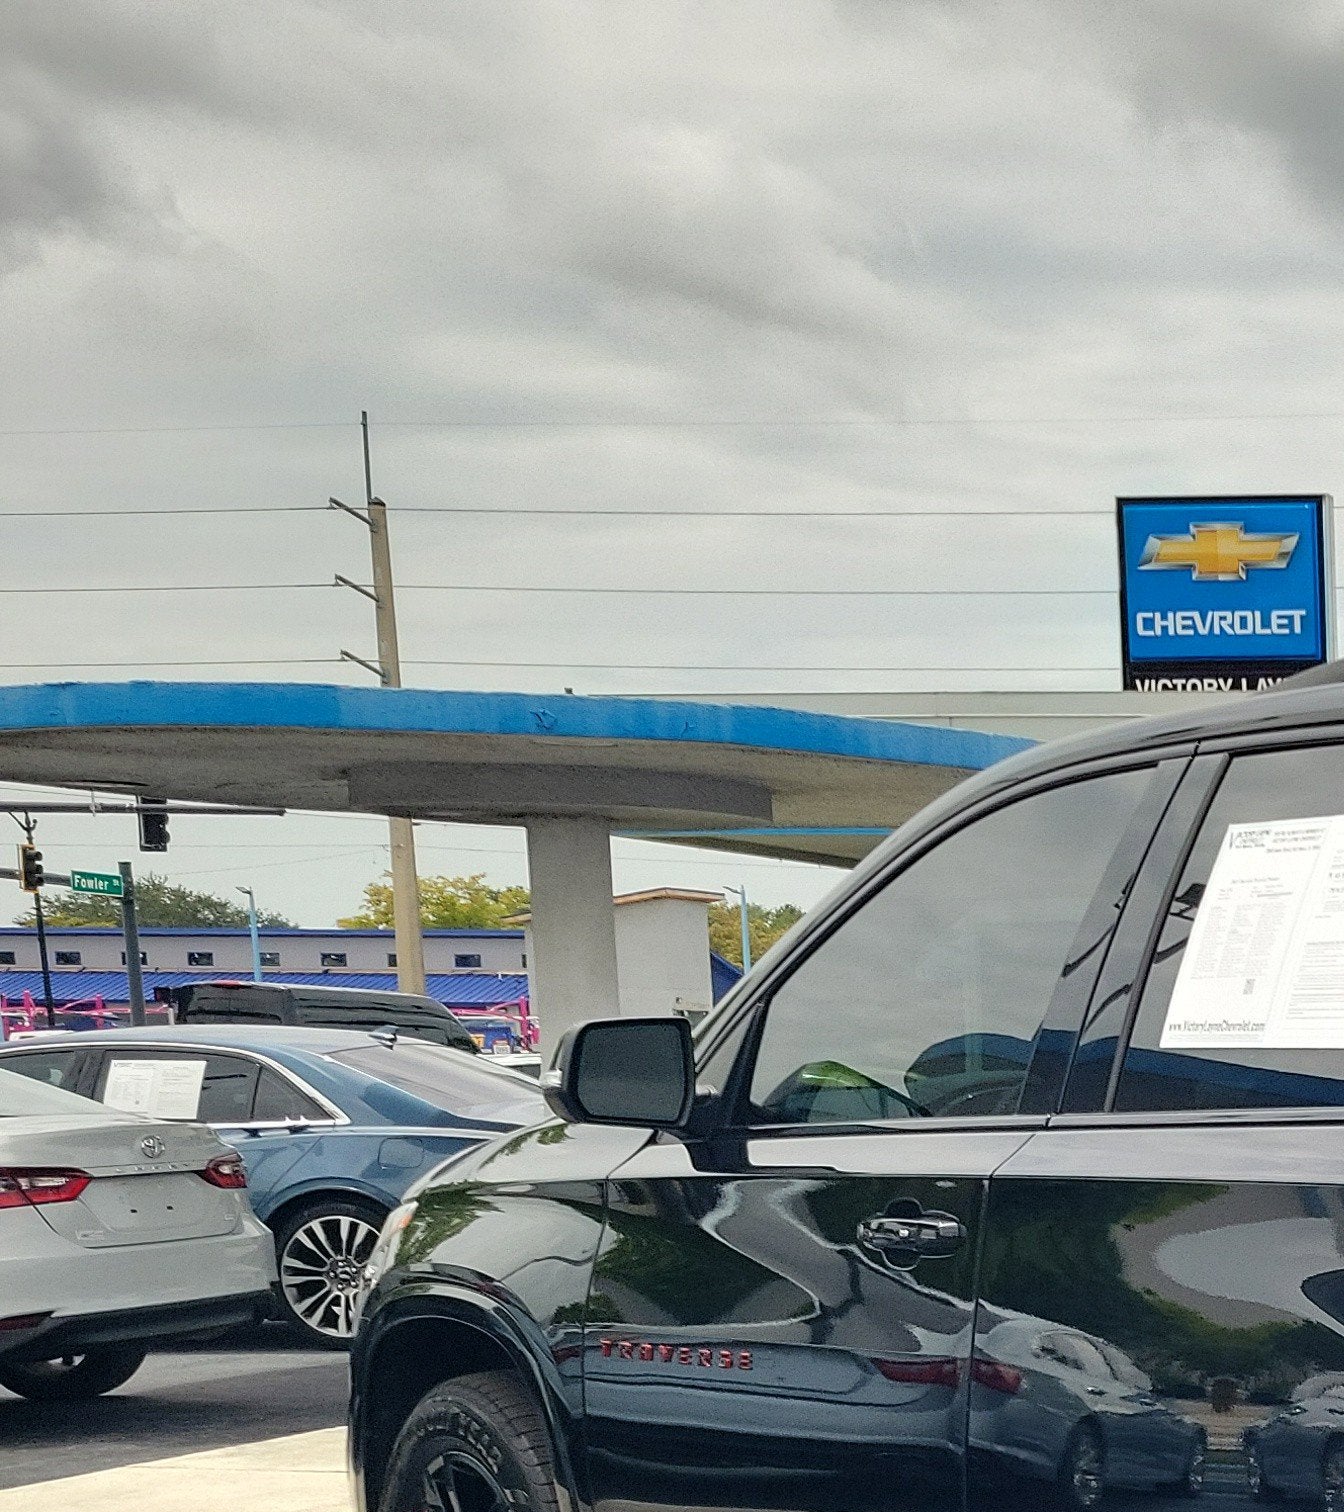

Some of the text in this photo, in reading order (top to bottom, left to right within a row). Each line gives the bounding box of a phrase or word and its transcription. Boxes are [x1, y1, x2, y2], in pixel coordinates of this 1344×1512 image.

[1136, 609, 1306, 637] CHEVROLET
[74, 874, 109, 890] Fowler
[600, 1339, 753, 1370] TRAVERSE
